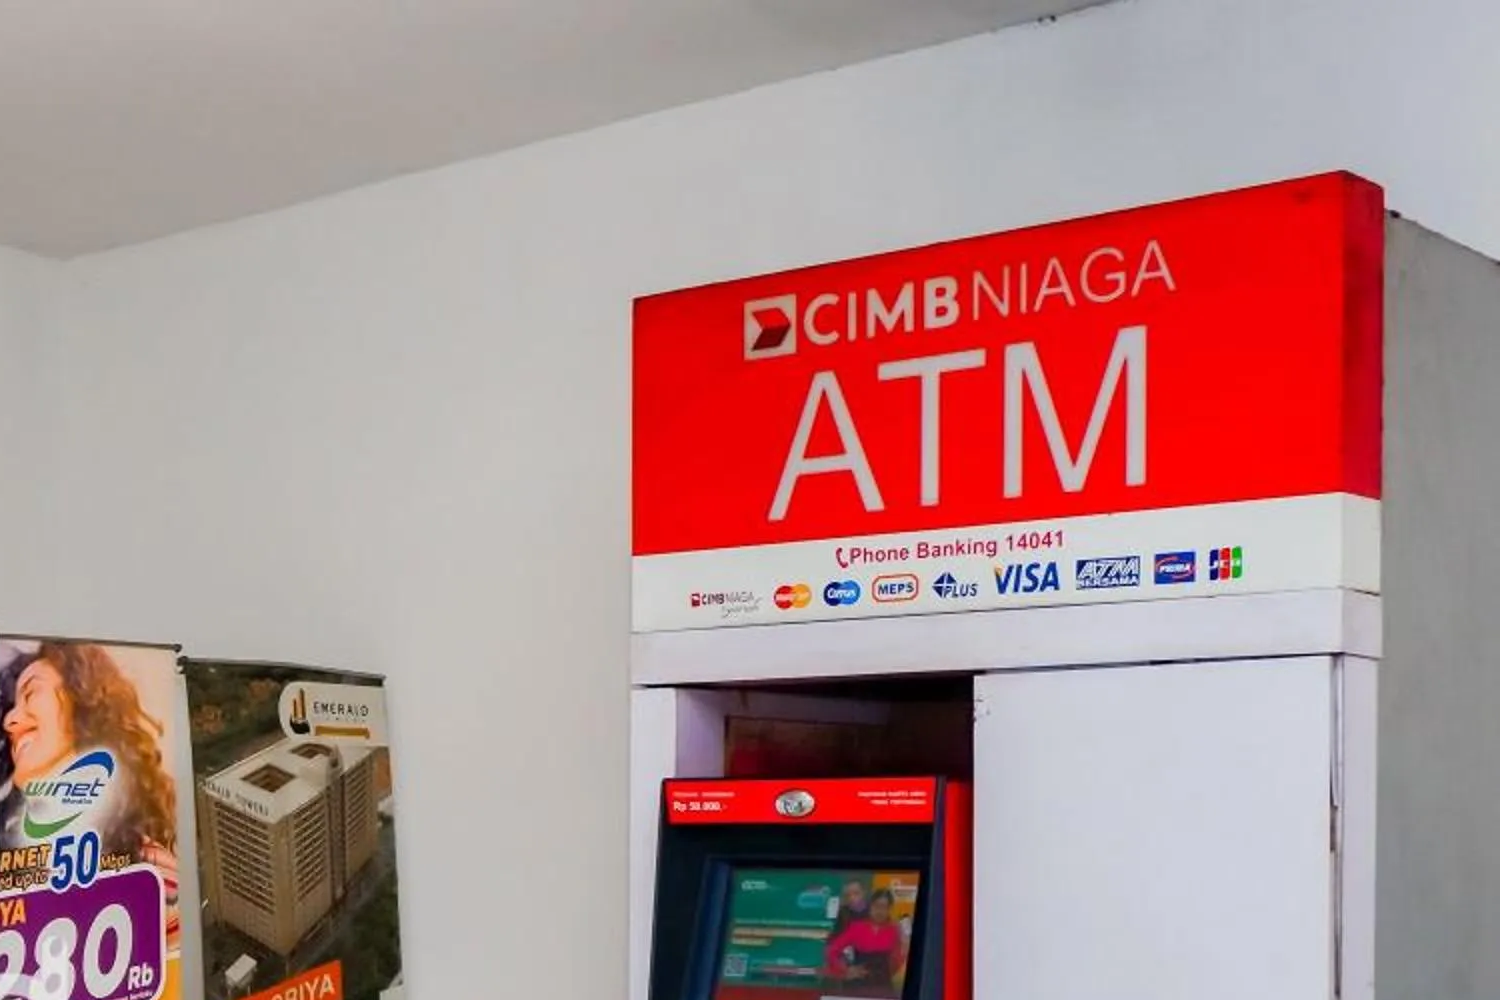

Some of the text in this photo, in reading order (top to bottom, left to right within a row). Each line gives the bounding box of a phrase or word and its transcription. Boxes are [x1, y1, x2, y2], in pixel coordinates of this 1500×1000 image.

[803, 239, 1177, 347] CIMB NIAGA
[766, 325, 1148, 522] ATM
[850, 530, 1064, 565] Phone Banking 14041
[877, 581, 915, 596] MEPS
[944, 583, 978, 599] PLUS
[993, 561, 1061, 595] VISA
[312, 701, 370, 717] EMERALD
[51, 831, 99, 890] 50
[127, 962, 155, 991] Rb
